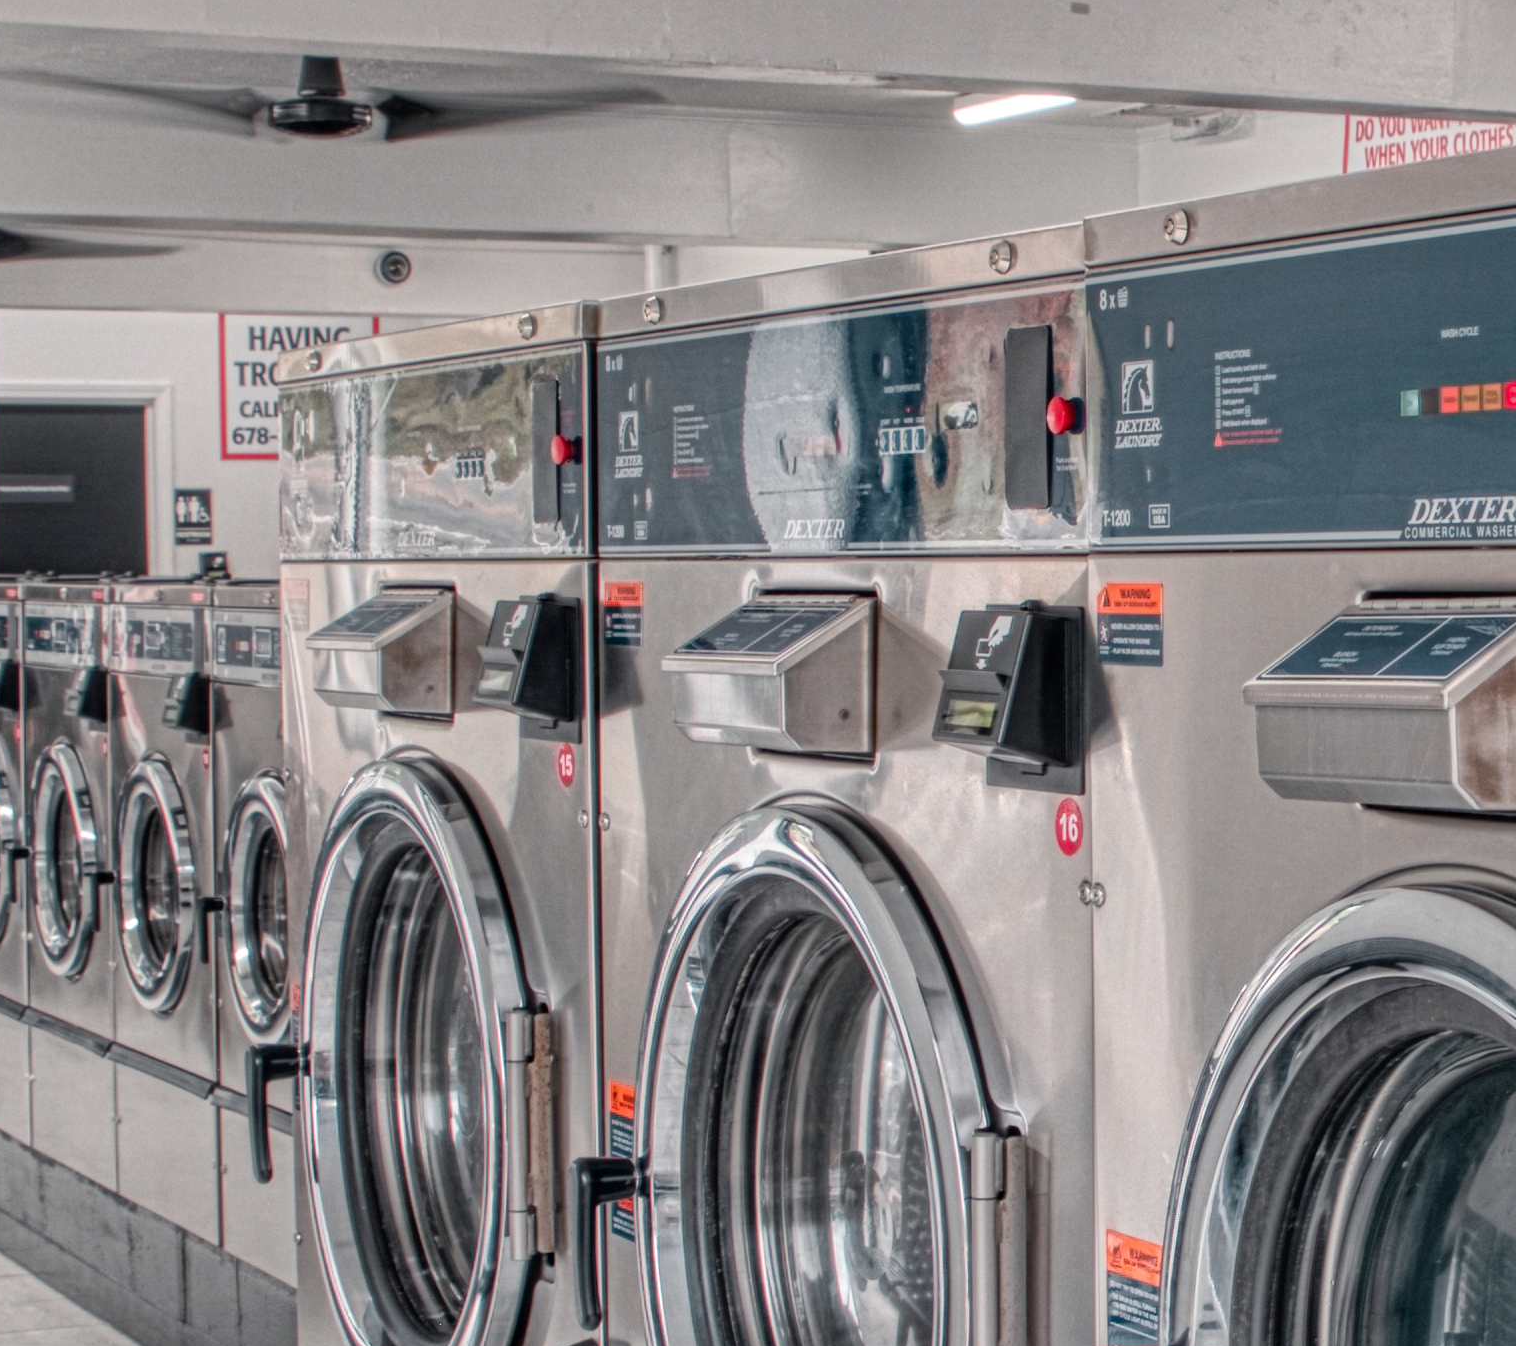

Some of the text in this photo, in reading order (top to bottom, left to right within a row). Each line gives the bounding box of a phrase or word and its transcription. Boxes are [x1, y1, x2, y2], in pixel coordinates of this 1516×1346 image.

[1356, 119, 1374, 142] DO
[1379, 116, 1405, 137] YOU
[1365, 125, 1513, 168] WHEN YOUR CLOTHES
[1100, 289, 1106, 310] 8
[1441, 327, 1479, 338] WASH CYCLE
[1116, 418, 1160, 434] DEXTER
[1115, 434, 1162, 448] LAUNDRY
[1103, 510, 1130, 527] T-1200
[784, 519, 845, 539] DEXTER
[1405, 526, 1472, 539] COMMERCIAL
[560, 754, 572, 776] 15
[1060, 813, 1078, 842] 16
